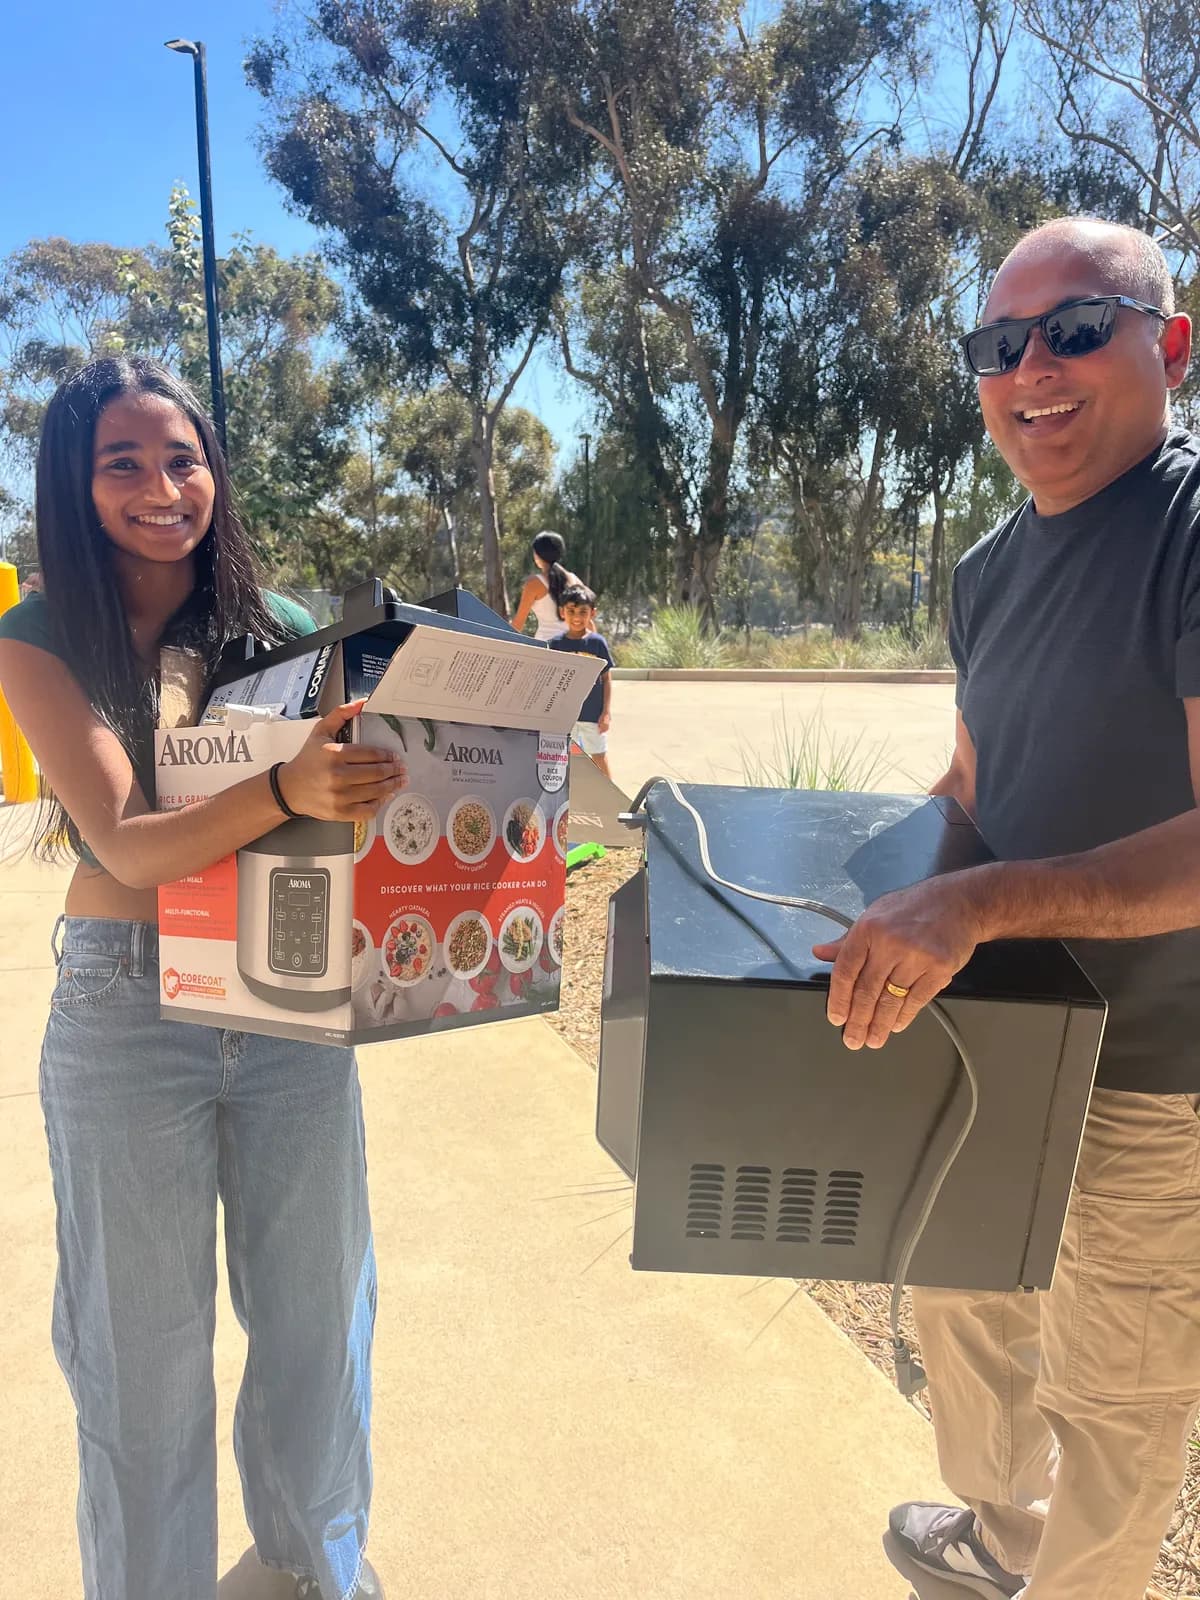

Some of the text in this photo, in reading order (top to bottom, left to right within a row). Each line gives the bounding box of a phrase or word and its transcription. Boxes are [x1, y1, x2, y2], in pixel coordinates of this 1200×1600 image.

[308, 644, 333, 697] CONAIR
[556, 668, 570, 690] START
[562, 669, 576, 692] QUICK
[158, 733, 254, 767] AROMA
[444, 742, 504, 765] AROMA
[542, 774, 563, 782] COUPON
[288, 879, 311, 889] AROMA
[380, 880, 547, 895] DISCOVER WHAT YOUR RICE COOKER CAN DO
[181, 972, 223, 987] CORECOAT
